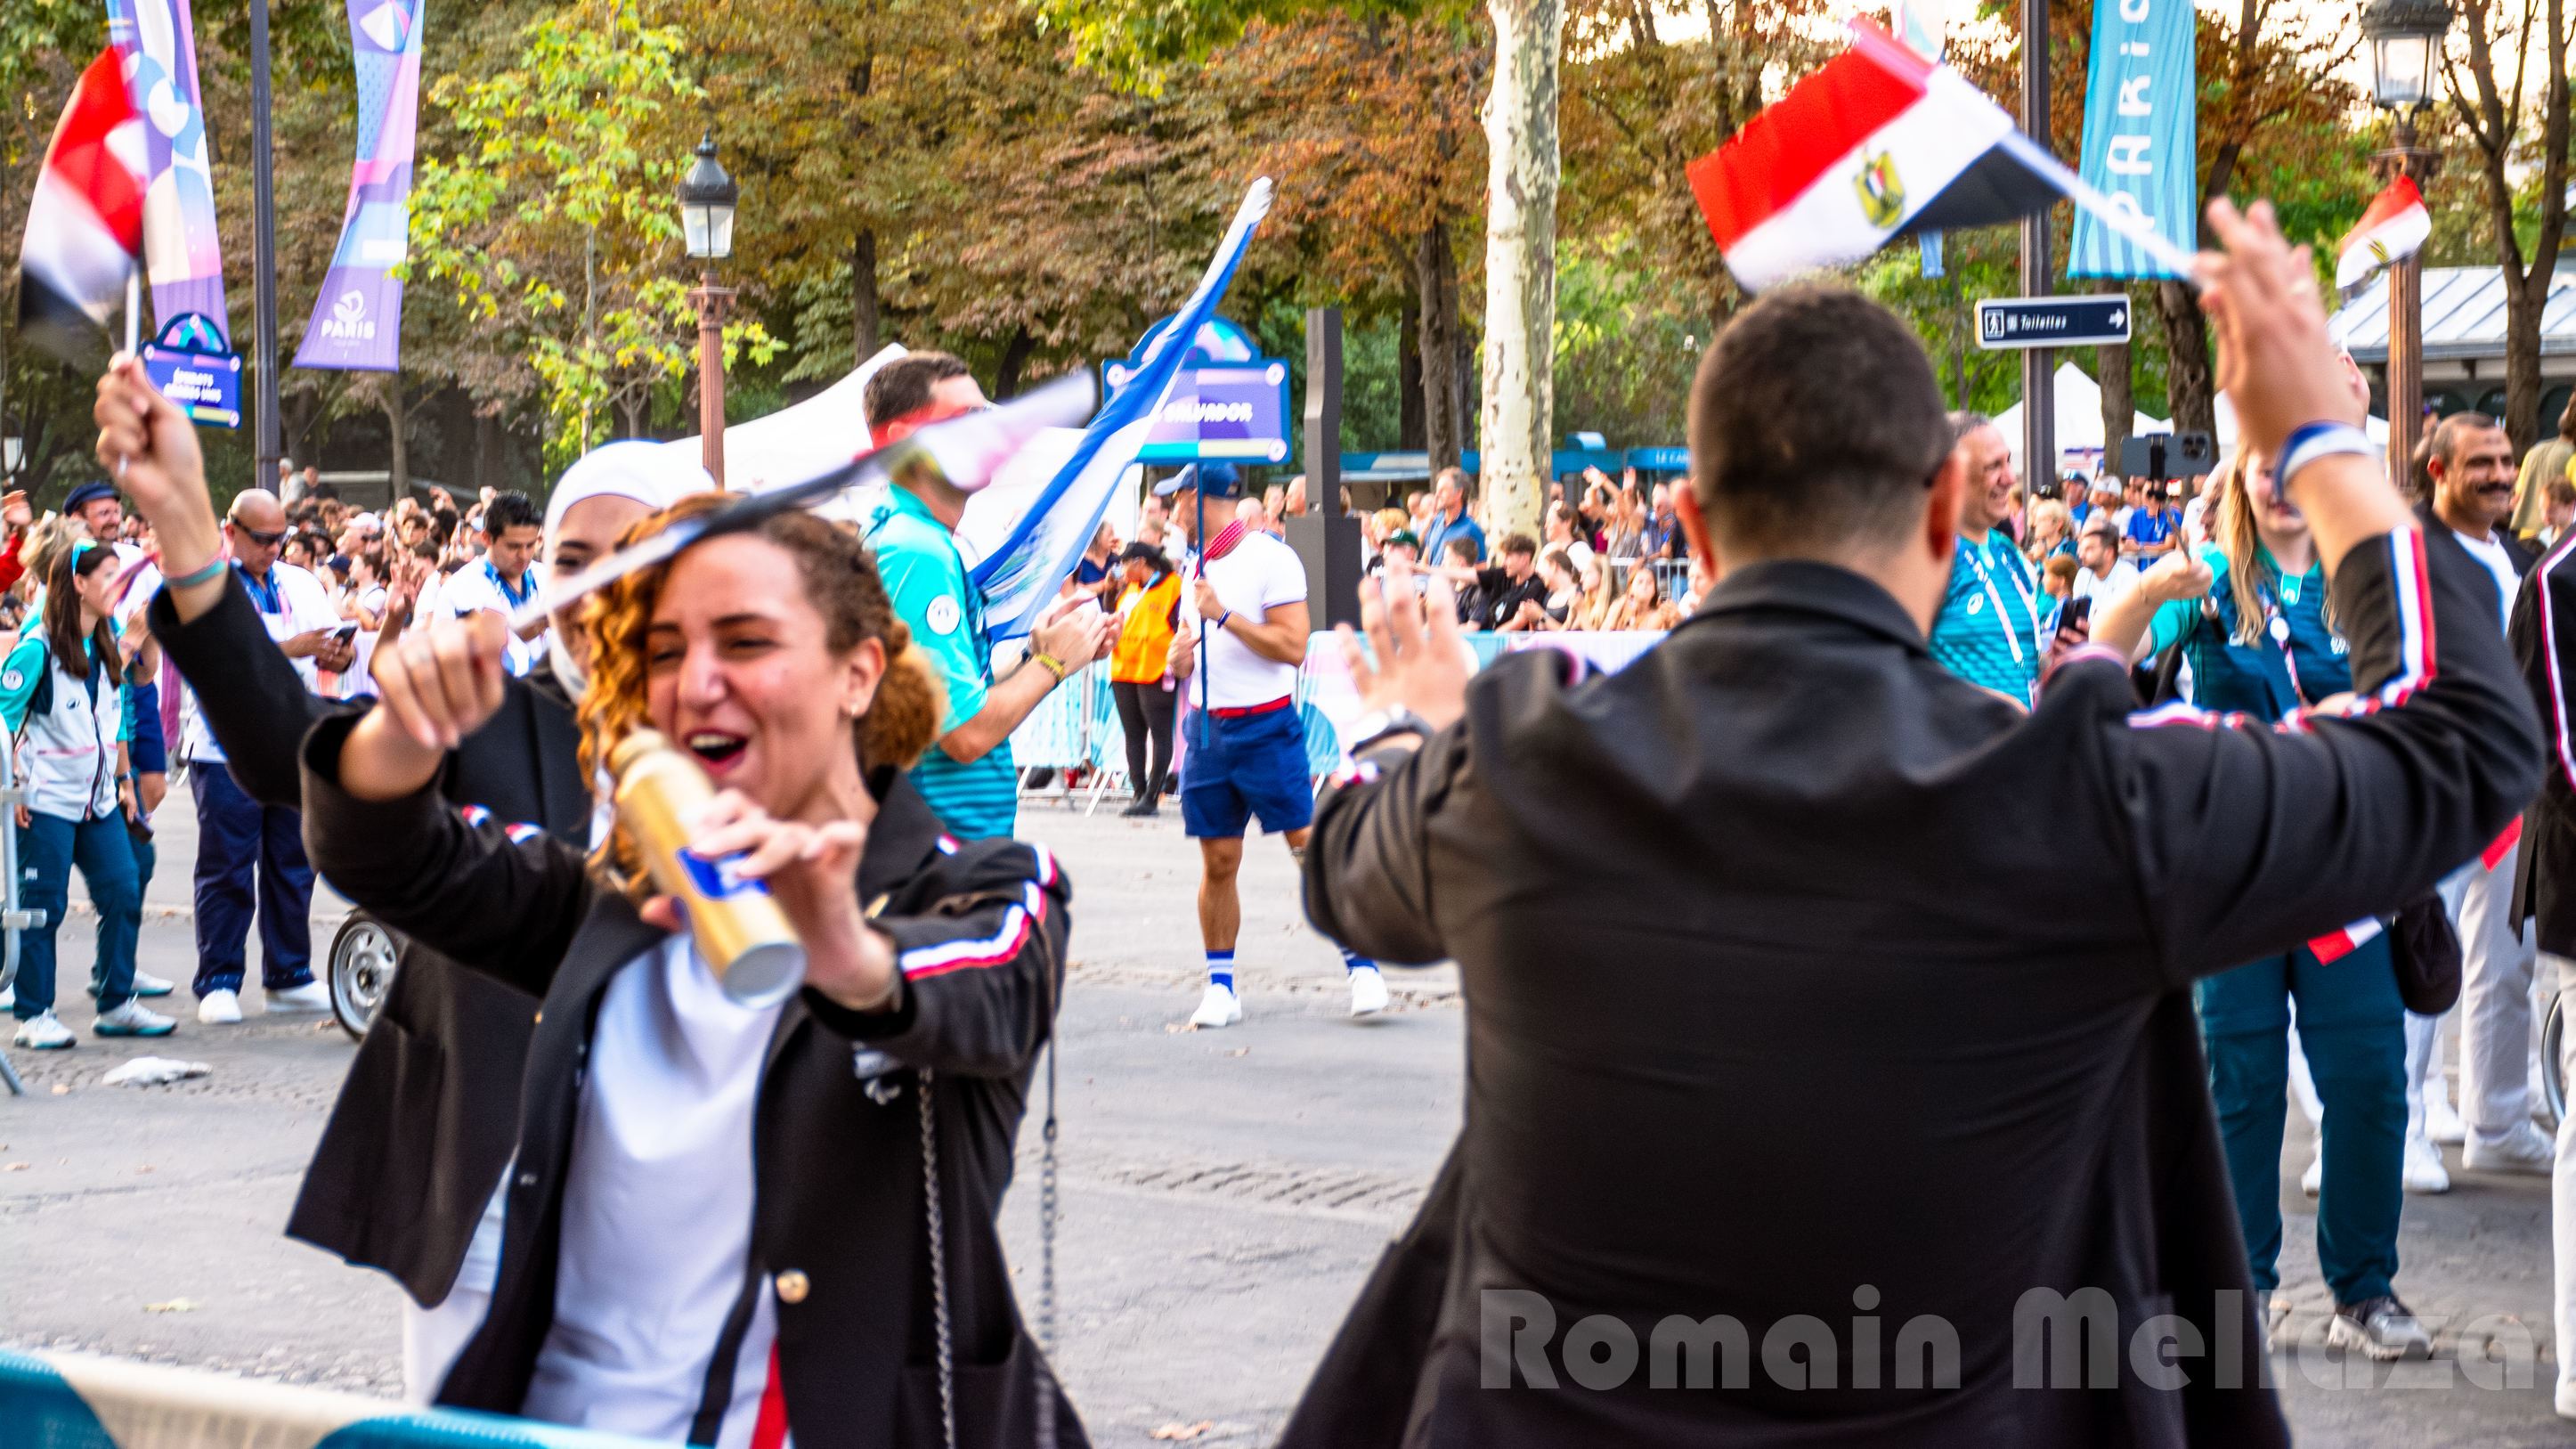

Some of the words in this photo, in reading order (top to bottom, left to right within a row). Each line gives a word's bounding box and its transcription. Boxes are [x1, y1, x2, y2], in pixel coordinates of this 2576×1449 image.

[321, 319, 375, 339] PARIS
[2020, 313, 2068, 331] Toilettes
[1163, 402, 1254, 423] SALVADOR
